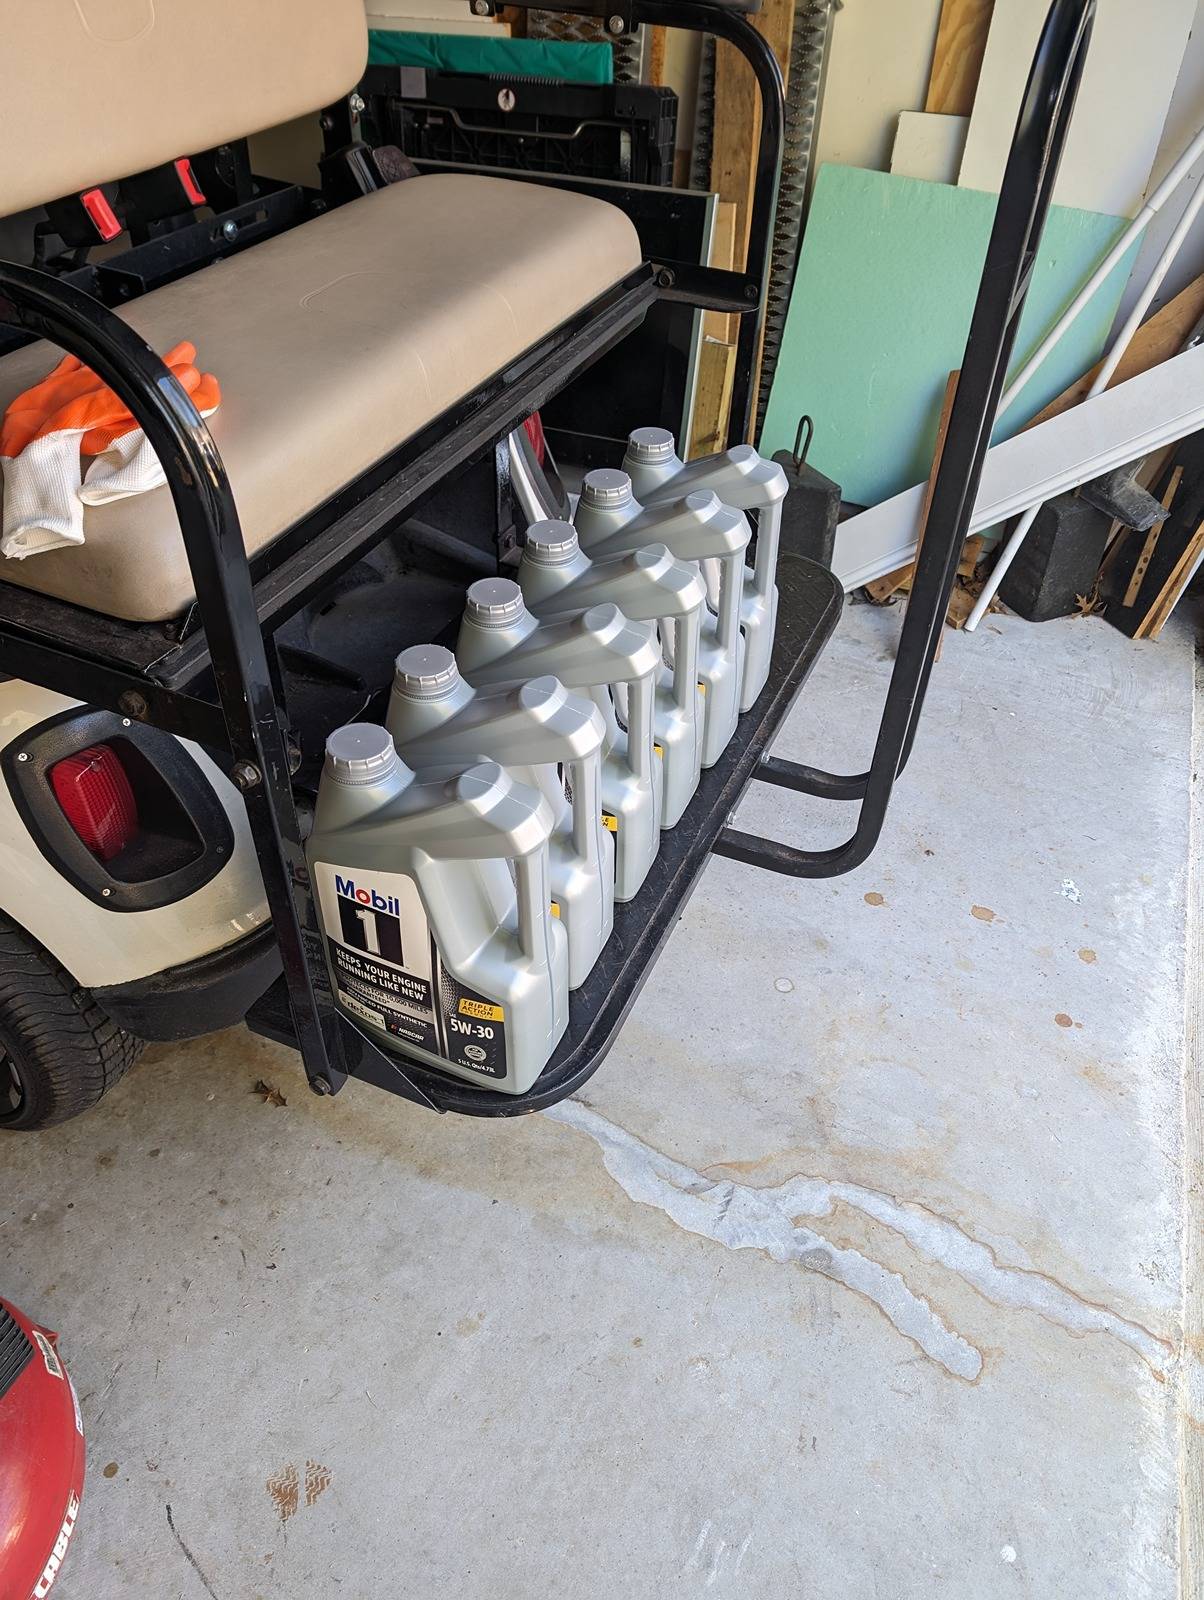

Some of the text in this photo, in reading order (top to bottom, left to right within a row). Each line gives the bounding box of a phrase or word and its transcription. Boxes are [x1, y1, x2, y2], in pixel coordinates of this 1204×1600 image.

[335, 874, 400, 916] Mobil
[355, 908, 381, 955] 1
[336, 947, 362, 968] KEEPS
[364, 962, 390, 980] YOUR
[391, 973, 427, 994] ENGINE
[337, 957, 377, 984] RUNNING
[379, 977, 400, 993] LIKE
[401, 986, 424, 1001] NEW
[461, 1005, 493, 1016] ACTION
[462, 1000, 495, 1011] TRIPLE
[398, 1027, 424, 1041] NASCAR
[450, 1018, 494, 1040] 5W-30
[34, 1498, 80, 1599] CABLE
